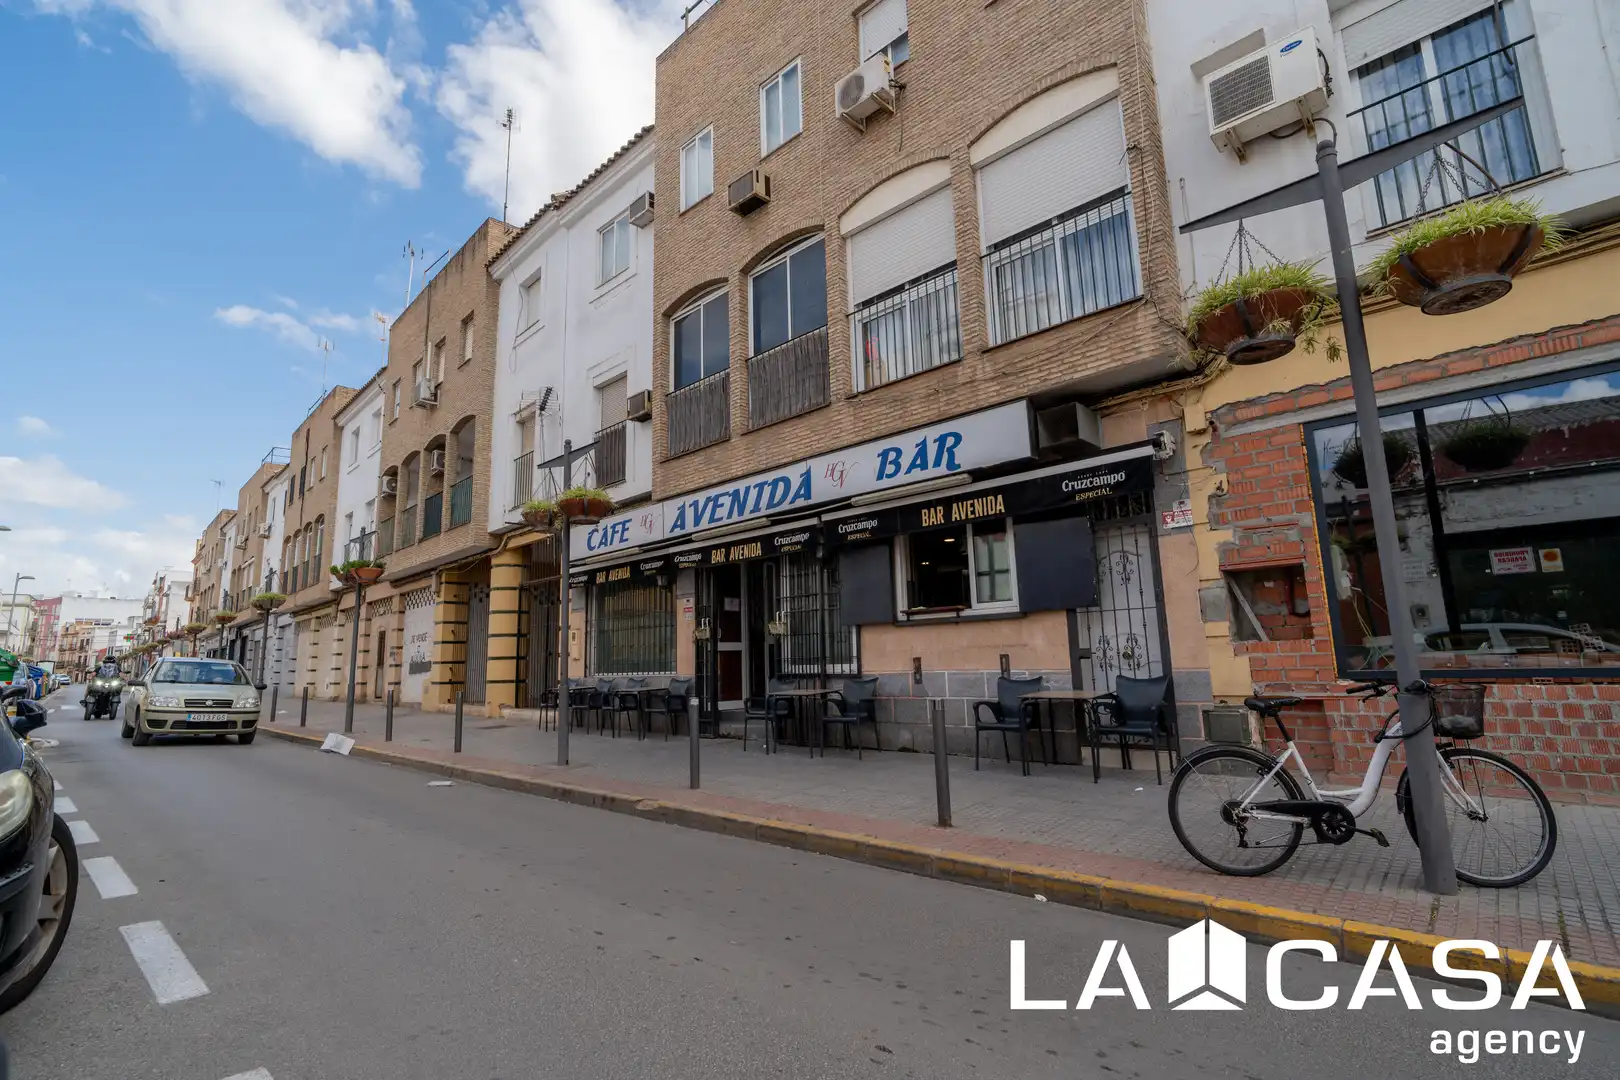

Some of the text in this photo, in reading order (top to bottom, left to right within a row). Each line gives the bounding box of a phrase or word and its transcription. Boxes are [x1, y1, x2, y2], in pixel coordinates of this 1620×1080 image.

[1062, 471, 1126, 491] Cruzcampo
[587, 519, 632, 551] CAFE
[669, 465, 812, 533] AVENIDA
[876, 431, 963, 481] BAR
[1075, 488, 1113, 500] ESPECIAL
[921, 495, 1005, 527] BAR AVENIDA
[838, 519, 877, 533] Cruzcampo
[774, 532, 809, 545] Cruzcampo
[711, 542, 762, 564] BAR AVENIDA
[596, 566, 631, 584] BAR AVENIDA
